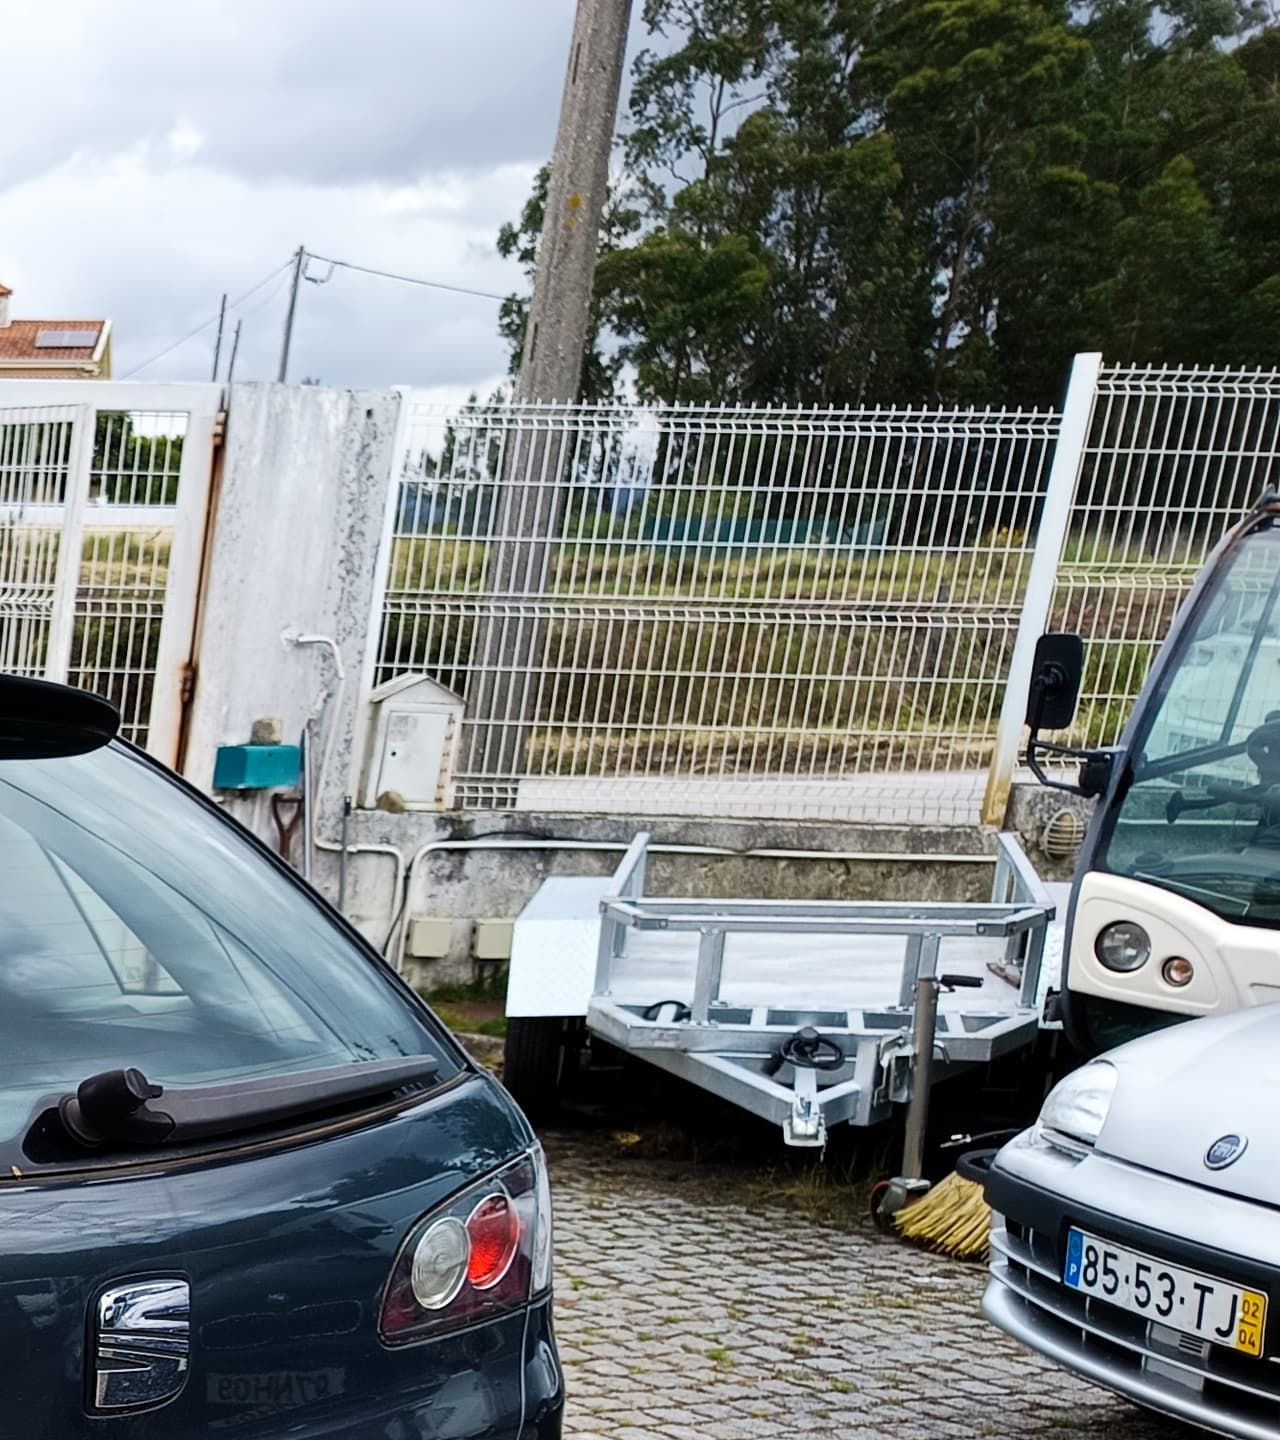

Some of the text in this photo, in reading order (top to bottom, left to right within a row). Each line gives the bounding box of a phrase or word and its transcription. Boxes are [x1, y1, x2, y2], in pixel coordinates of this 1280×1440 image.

[1069, 1263, 1077, 1276] P
[1242, 1298, 1260, 1319] 02
[1239, 1330, 1256, 1349] 04
